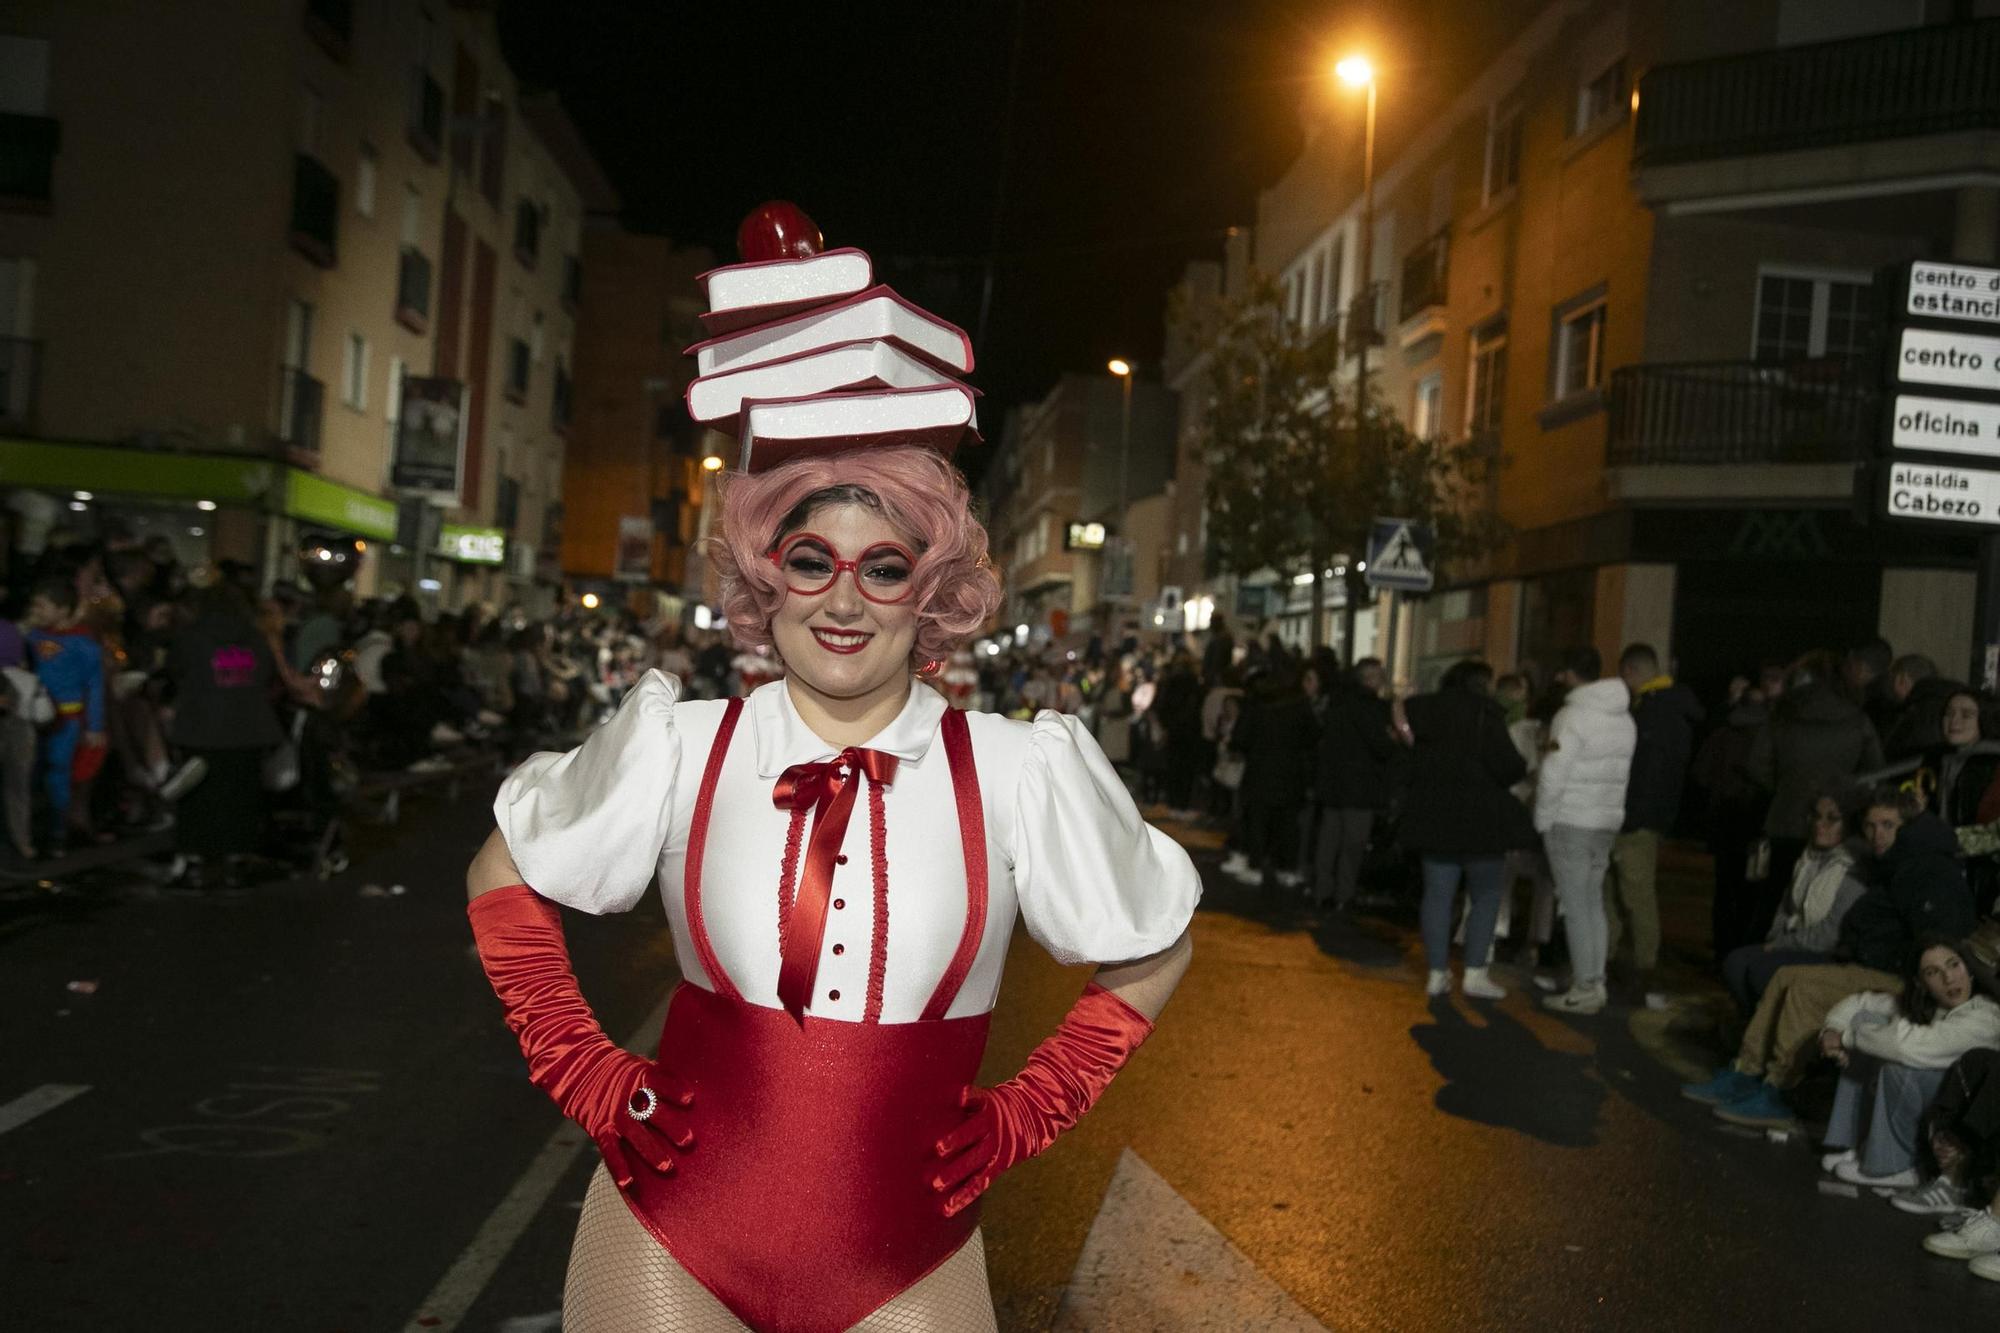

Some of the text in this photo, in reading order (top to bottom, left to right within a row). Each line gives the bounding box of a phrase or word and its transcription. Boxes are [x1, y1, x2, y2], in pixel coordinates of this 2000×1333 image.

[1914, 268, 1977, 289] centro
[1904, 346, 1982, 370] centro
[1899, 410, 1980, 437] oficina
[1894, 489, 1980, 516] Cabezo
